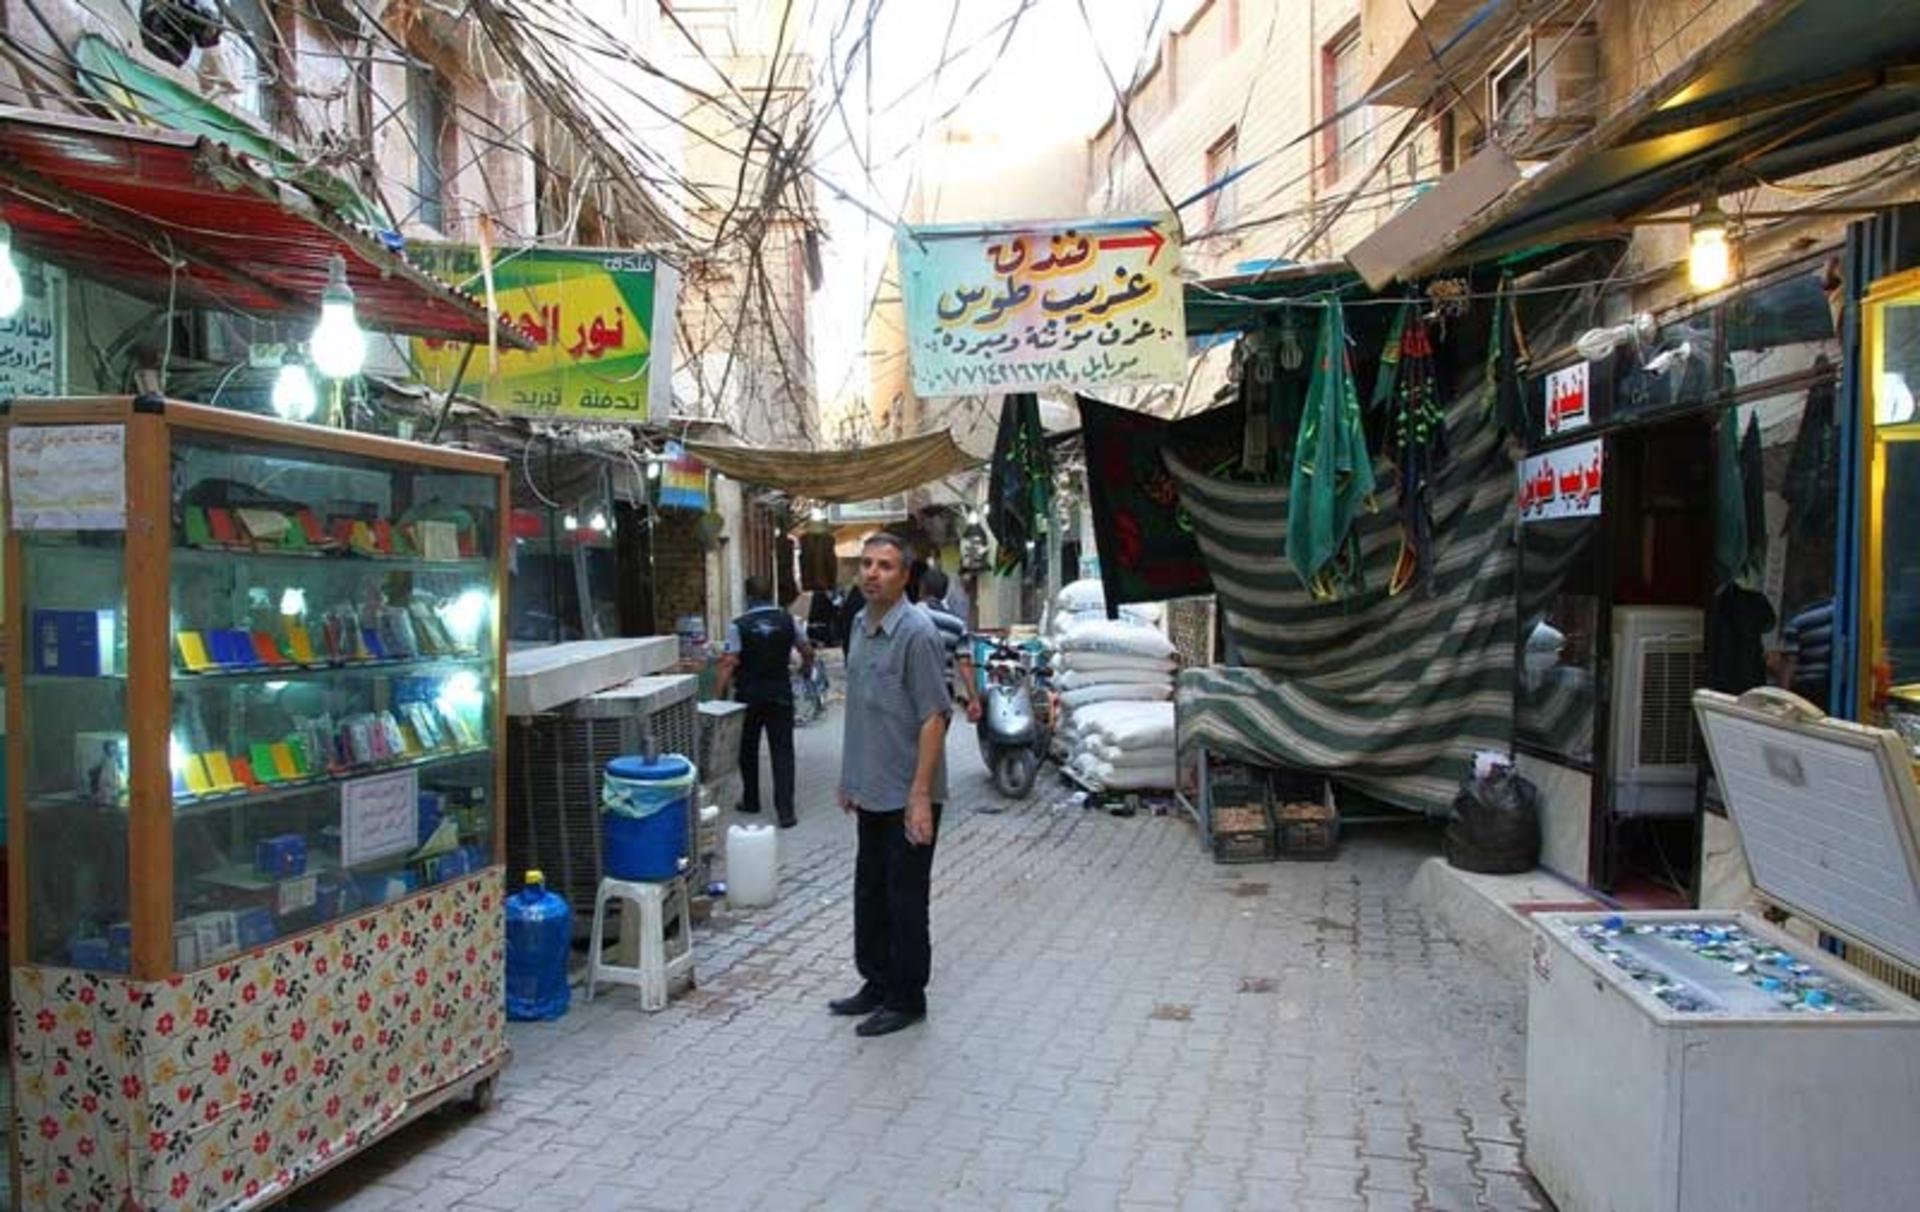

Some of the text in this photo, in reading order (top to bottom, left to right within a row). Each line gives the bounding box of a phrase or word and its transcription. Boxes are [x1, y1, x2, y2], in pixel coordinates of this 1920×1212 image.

[987, 230, 1093, 274] فندق
[936, 265, 1153, 325] غريب طوس
[567, 305, 626, 359] نور
[1097, 319, 1157, 347] غرف
[1548, 367, 1586, 432] فندق
[1518, 446, 1601, 517] غريب طوس
